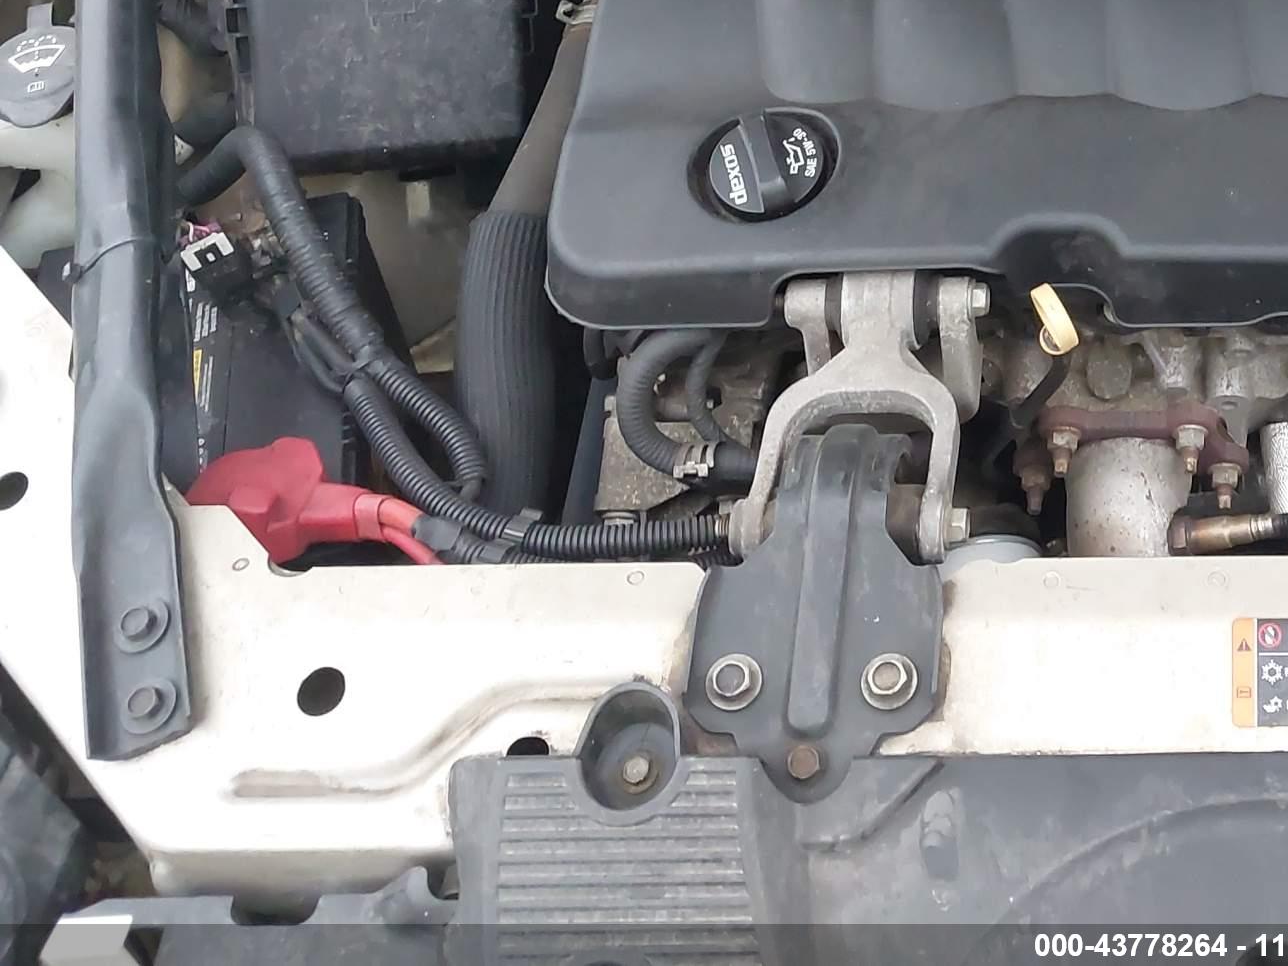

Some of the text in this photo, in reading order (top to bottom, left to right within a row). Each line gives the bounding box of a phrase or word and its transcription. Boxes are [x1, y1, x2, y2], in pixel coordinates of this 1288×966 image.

[720, 144, 748, 205] dexos
[792, 127, 817, 177] SAE 5W-30
